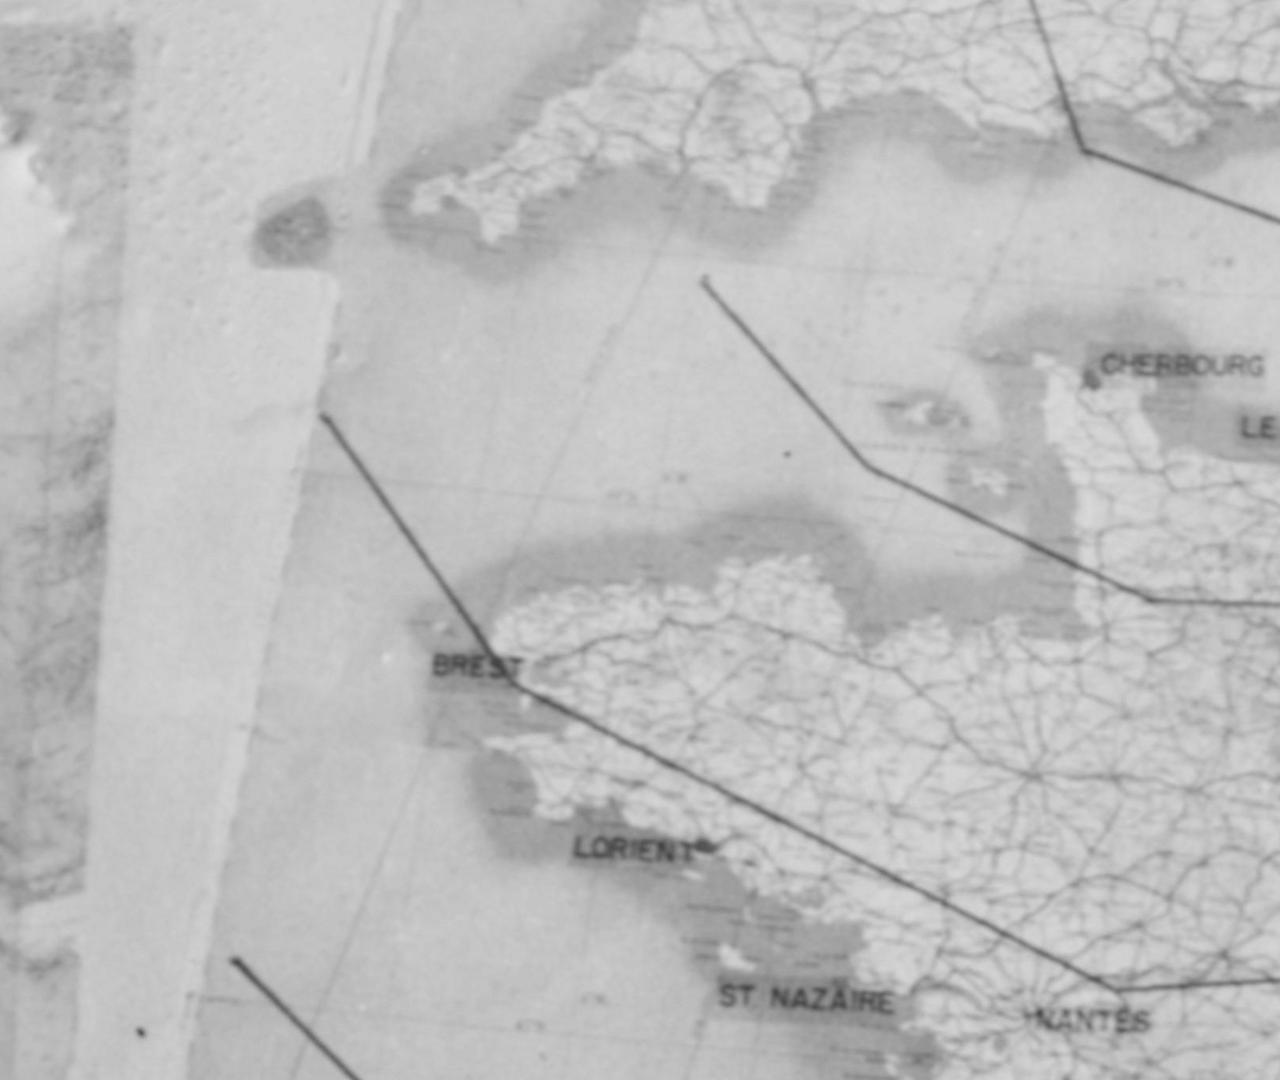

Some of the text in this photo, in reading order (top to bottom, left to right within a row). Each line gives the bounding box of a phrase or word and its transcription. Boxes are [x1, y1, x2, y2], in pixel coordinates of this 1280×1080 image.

[1100, 352, 1266, 378] CHERBOURG
[1240, 415, 1278, 440] LE
[432, 653, 522, 679] BREST
[573, 835, 693, 863] LORIENT
[718, 984, 895, 1015] ST NAZAIRE
[1035, 1005, 1152, 1033] NANTES
